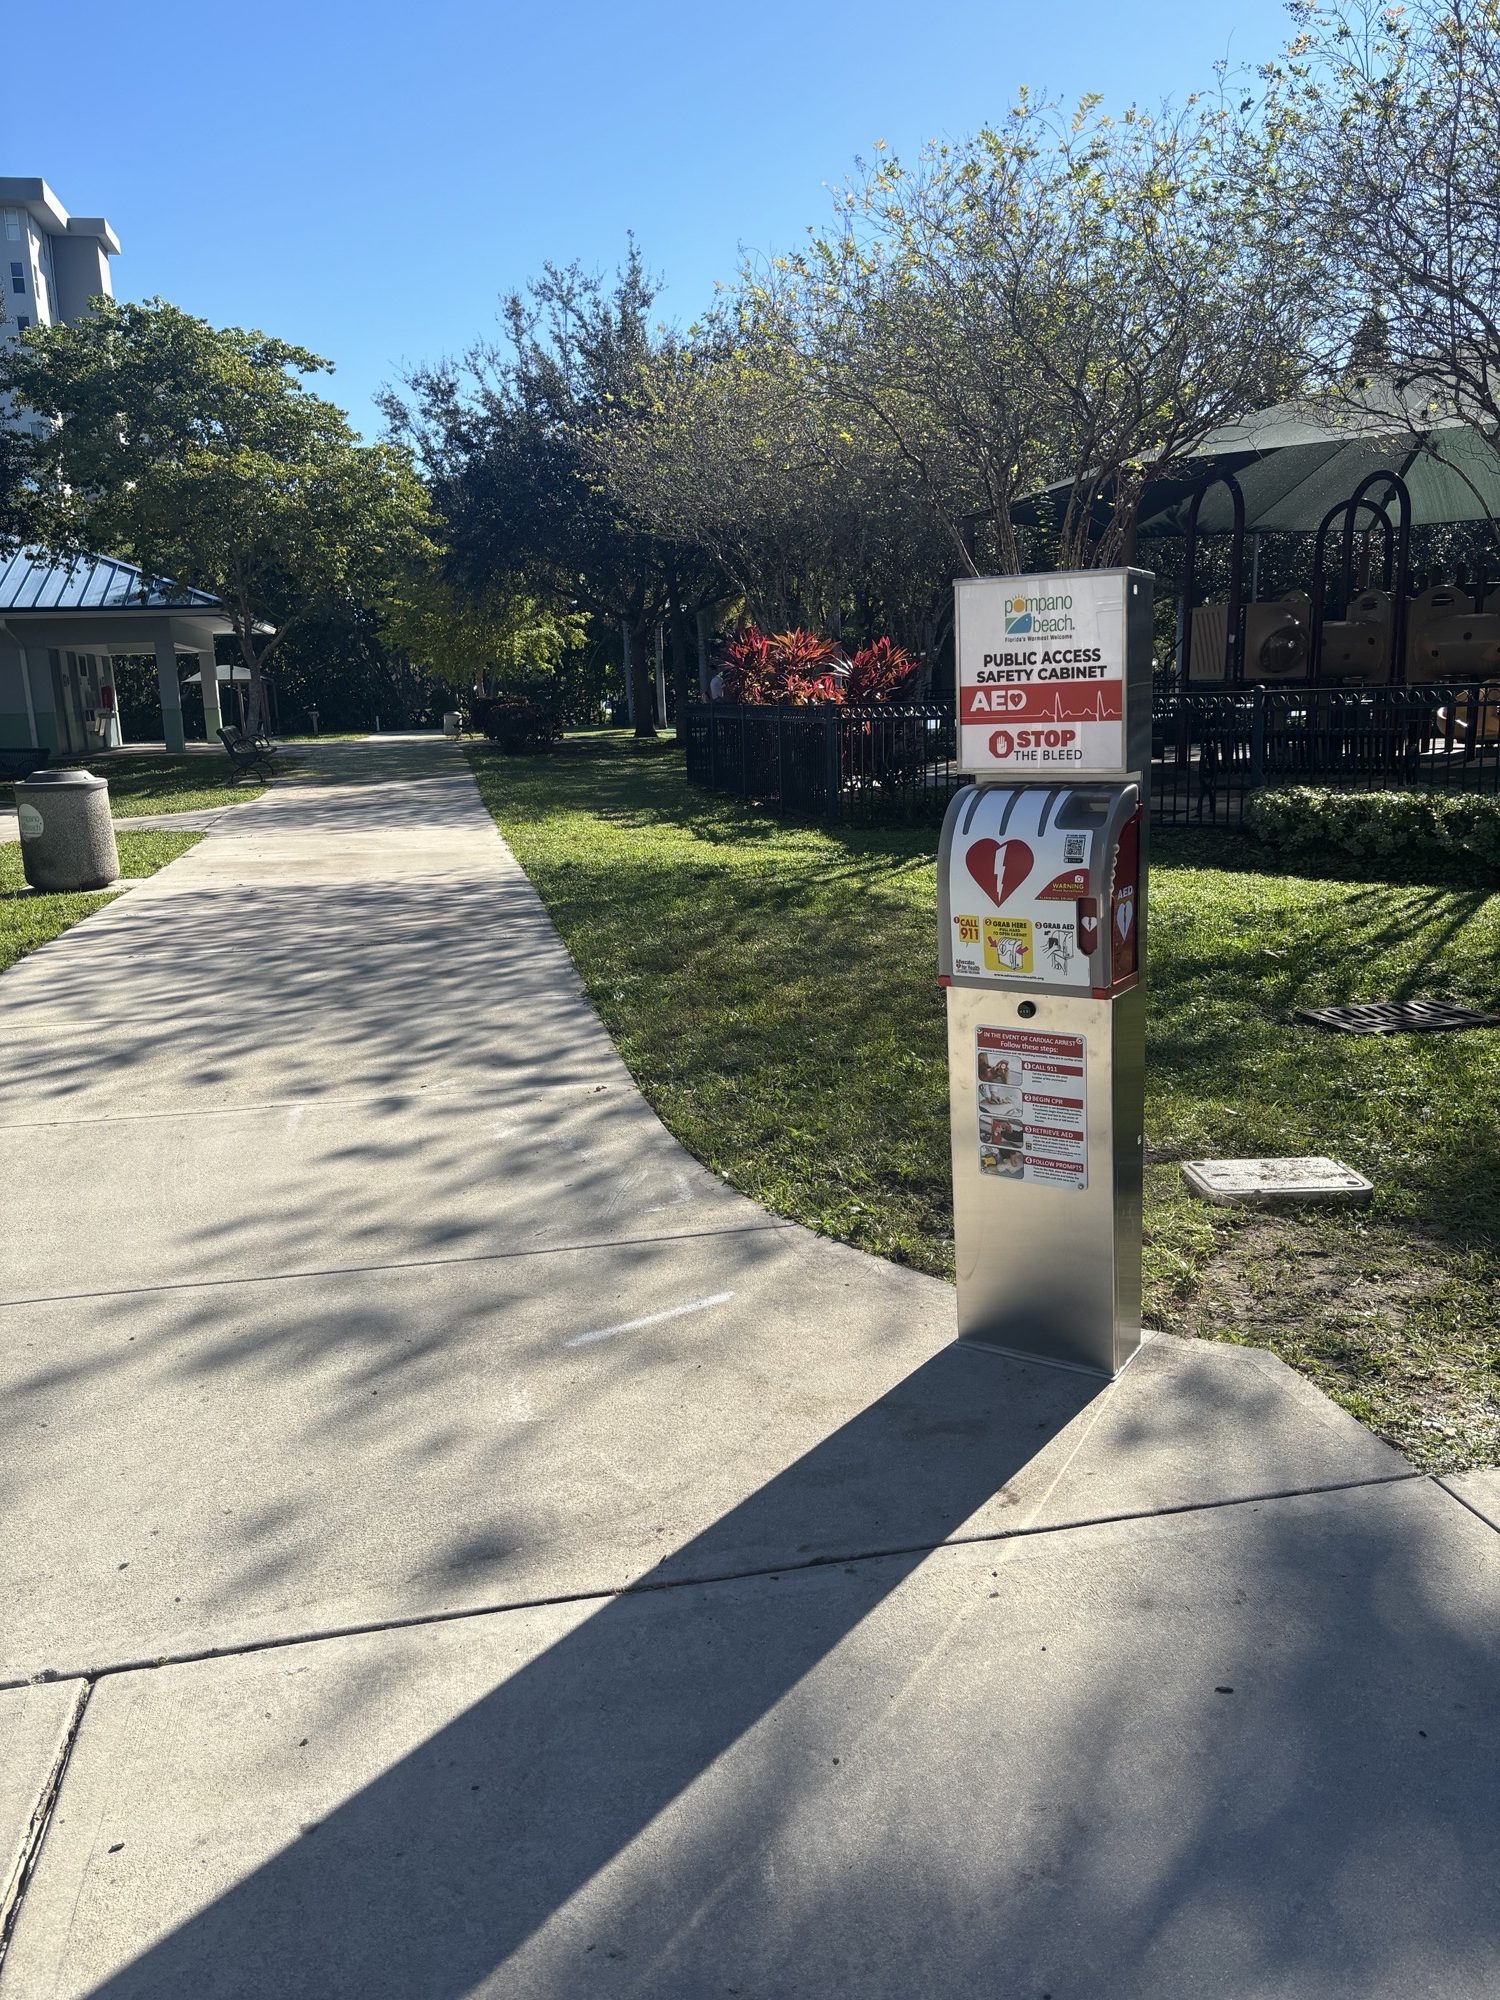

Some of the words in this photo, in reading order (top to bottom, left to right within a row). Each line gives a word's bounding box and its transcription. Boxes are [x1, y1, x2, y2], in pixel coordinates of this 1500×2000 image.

[1005, 595, 1072, 617] pompano
[984, 652, 1037, 667] PUBLIC
[1041, 648, 1101, 664] ACCESS
[977, 669, 1034, 683] SAFETY
[1038, 666, 1107, 681] CABINET
[970, 689, 1027, 712] AED
[1017, 730, 1076, 748] STOP
[1014, 751, 1037, 761] THE
[1043, 750, 1083, 761] BLEED
[1118, 885, 1133, 900] AED
[960, 918, 979, 928] CALL
[1043, 922, 1060, 930] GRAB
[960, 928, 979, 940] 911
[1000, 1041, 1021, 1049] Follow
[1022, 1043, 1039, 1051] these
[1029, 1037, 1054, 1045] CARDIAC
[1055, 1039, 1075, 1047] ARREST
[1033, 1128, 1060, 1137] RETRIEVE
[1033, 1159, 1055, 1167] FOLLOW
[1056, 1162, 1082, 1171] PROMPTS
